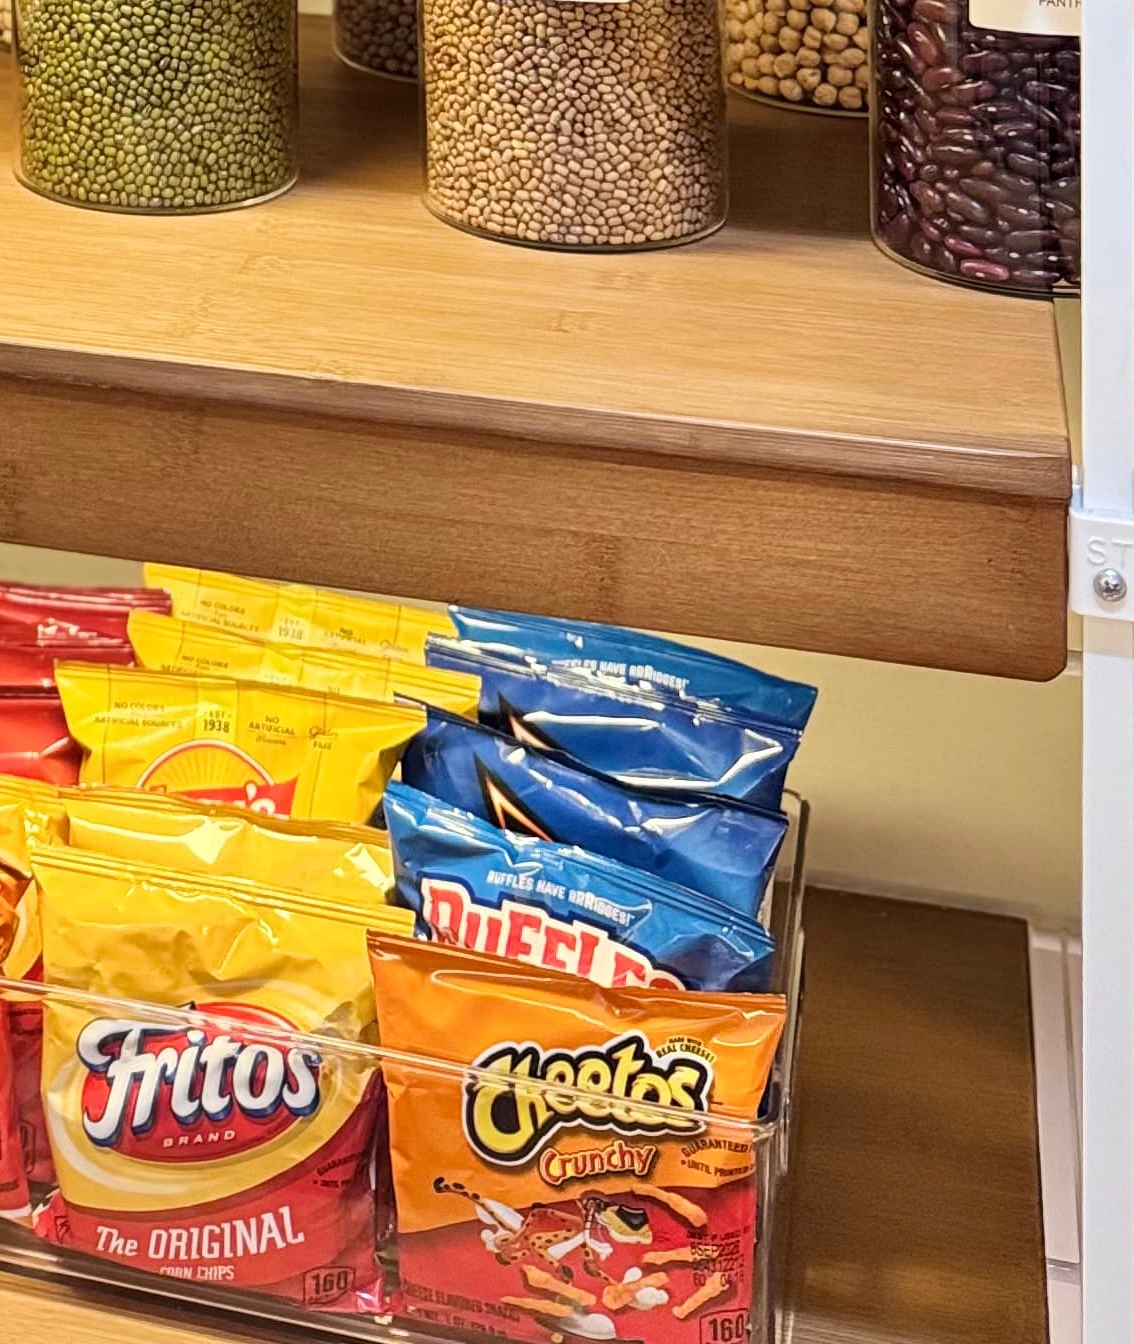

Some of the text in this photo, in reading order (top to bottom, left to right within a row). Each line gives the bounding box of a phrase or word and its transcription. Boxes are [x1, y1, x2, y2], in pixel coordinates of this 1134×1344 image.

[1087, 536, 1134, 568] ST
[202, 718, 230, 734] 1938
[486, 870, 534, 892] RUFFLES
[536, 879, 565, 899] HAVE
[656, 1044, 677, 1059] REAL
[77, 1018, 323, 1148] Fritos
[465, 1034, 706, 1162] Cheetos
[162, 1129, 236, 1148] BRAND
[680, 1139, 748, 1158] GUARANTEED
[542, 1143, 655, 1182] Crunchy
[95, 1205, 306, 1261] The ORIGINAL
[196, 1265, 235, 1281] CHIPS
[311, 1269, 350, 1297] 160
[708, 1312, 745, 1343] 160
